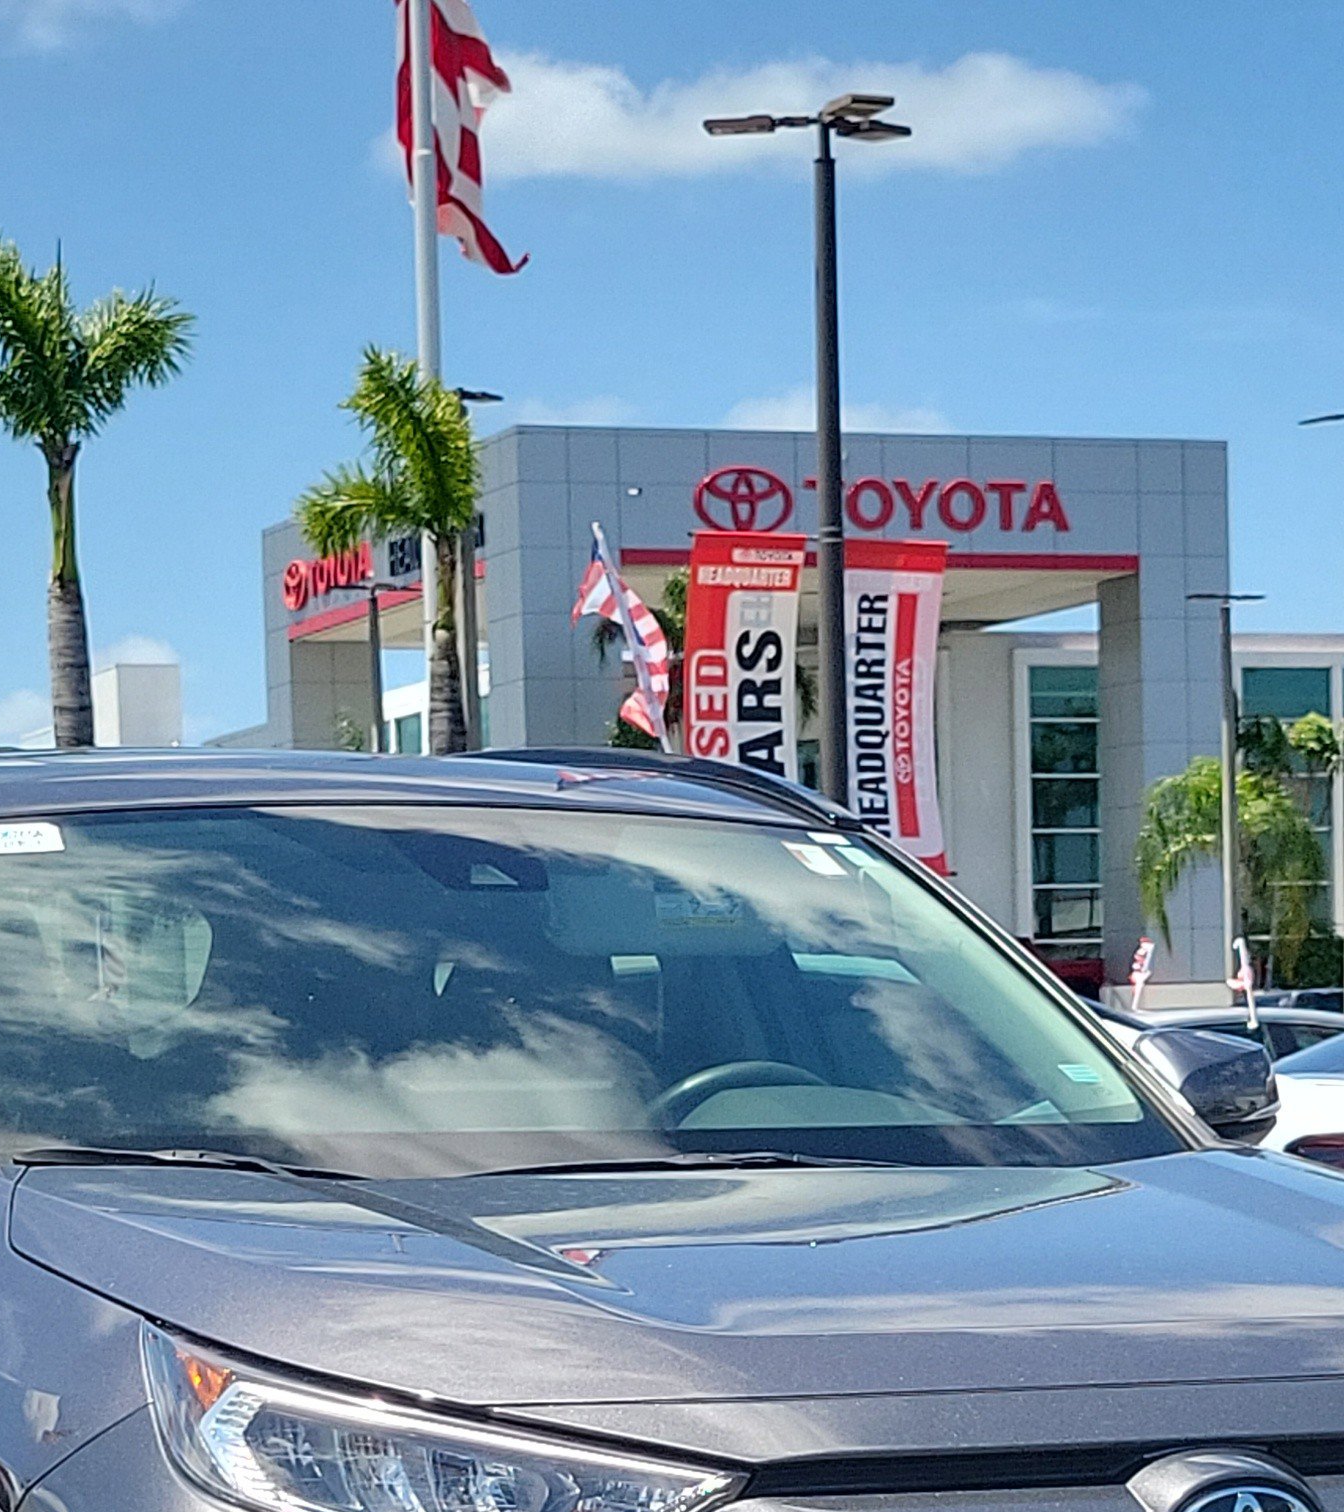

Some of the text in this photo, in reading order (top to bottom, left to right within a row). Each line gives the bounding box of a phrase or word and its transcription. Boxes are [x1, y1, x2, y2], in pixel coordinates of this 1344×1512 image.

[803, 479, 1069, 532] OYOTA
[695, 653, 729, 758] SED
[736, 629, 785, 777] ARS
[895, 658, 912, 755] TOYOTA
